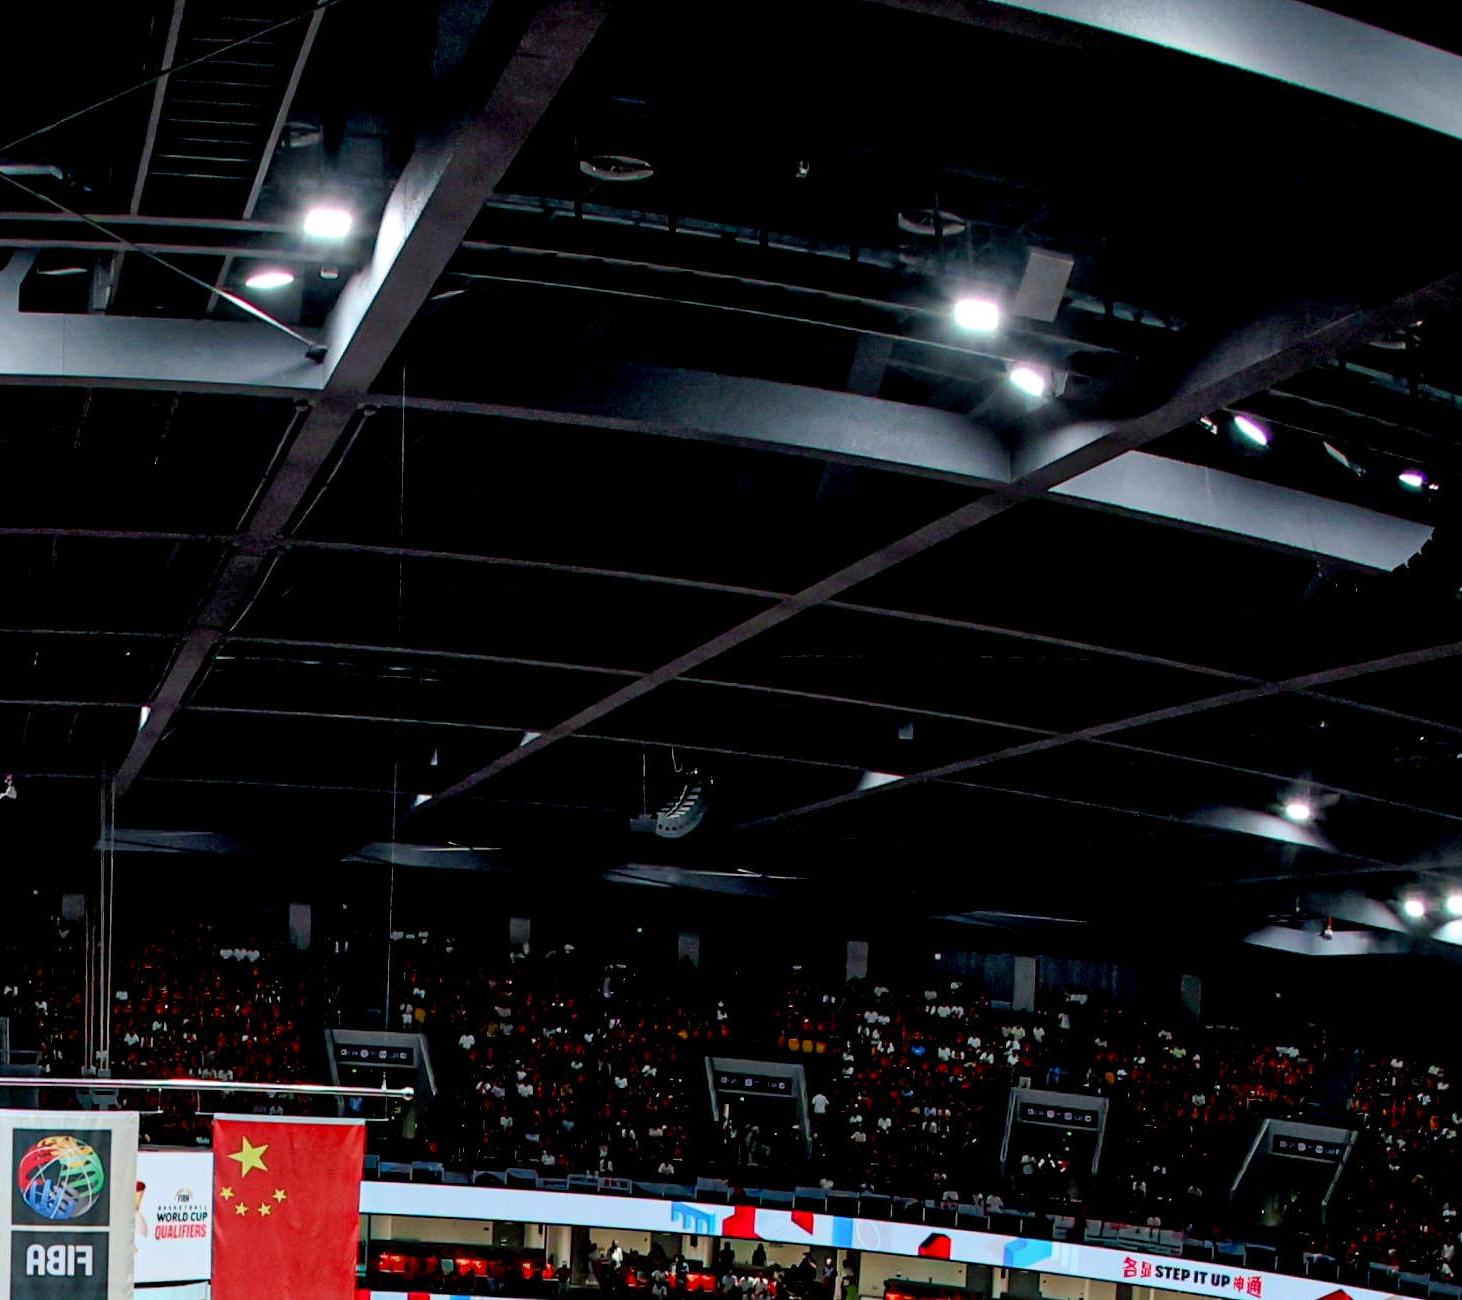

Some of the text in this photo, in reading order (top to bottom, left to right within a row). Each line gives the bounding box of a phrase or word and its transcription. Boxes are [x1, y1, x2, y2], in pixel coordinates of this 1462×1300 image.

[156, 1211, 208, 1223] WORLD CUP
[154, 1223, 207, 1241] QUALIFIERS
[1155, 1264, 1191, 1282] STEP
[1193, 1269, 1208, 1285] IT
[1210, 1272, 1231, 1288] UP
